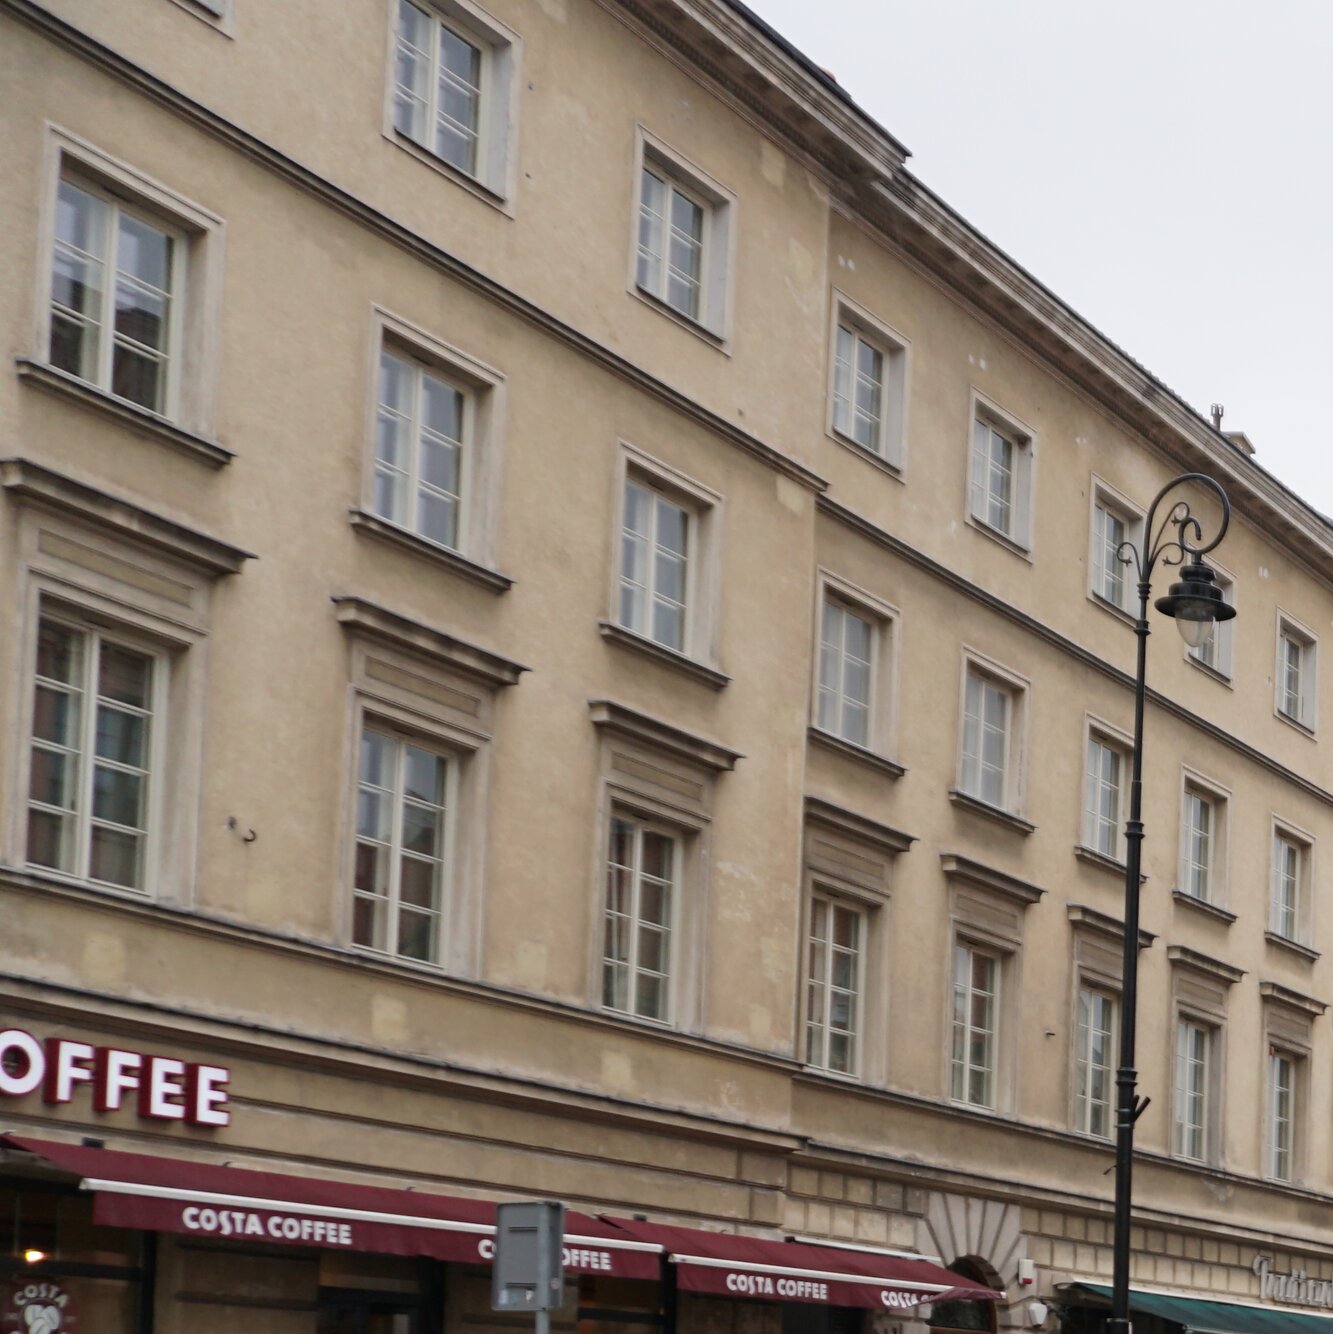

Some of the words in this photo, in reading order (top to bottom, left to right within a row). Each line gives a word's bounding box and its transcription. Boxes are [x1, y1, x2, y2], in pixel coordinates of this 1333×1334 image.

[0, 1029, 230, 1126] OFFEE
[182, 1206, 264, 1236] COSTA
[267, 1215, 352, 1245] COFFEE
[561, 1248, 611, 1270] OFFEE
[15, 1283, 68, 1308] COSTA
[726, 1273, 774, 1295] COSTA
[776, 1279, 828, 1300] COFFEE
[881, 1290, 919, 1308] COSTA
